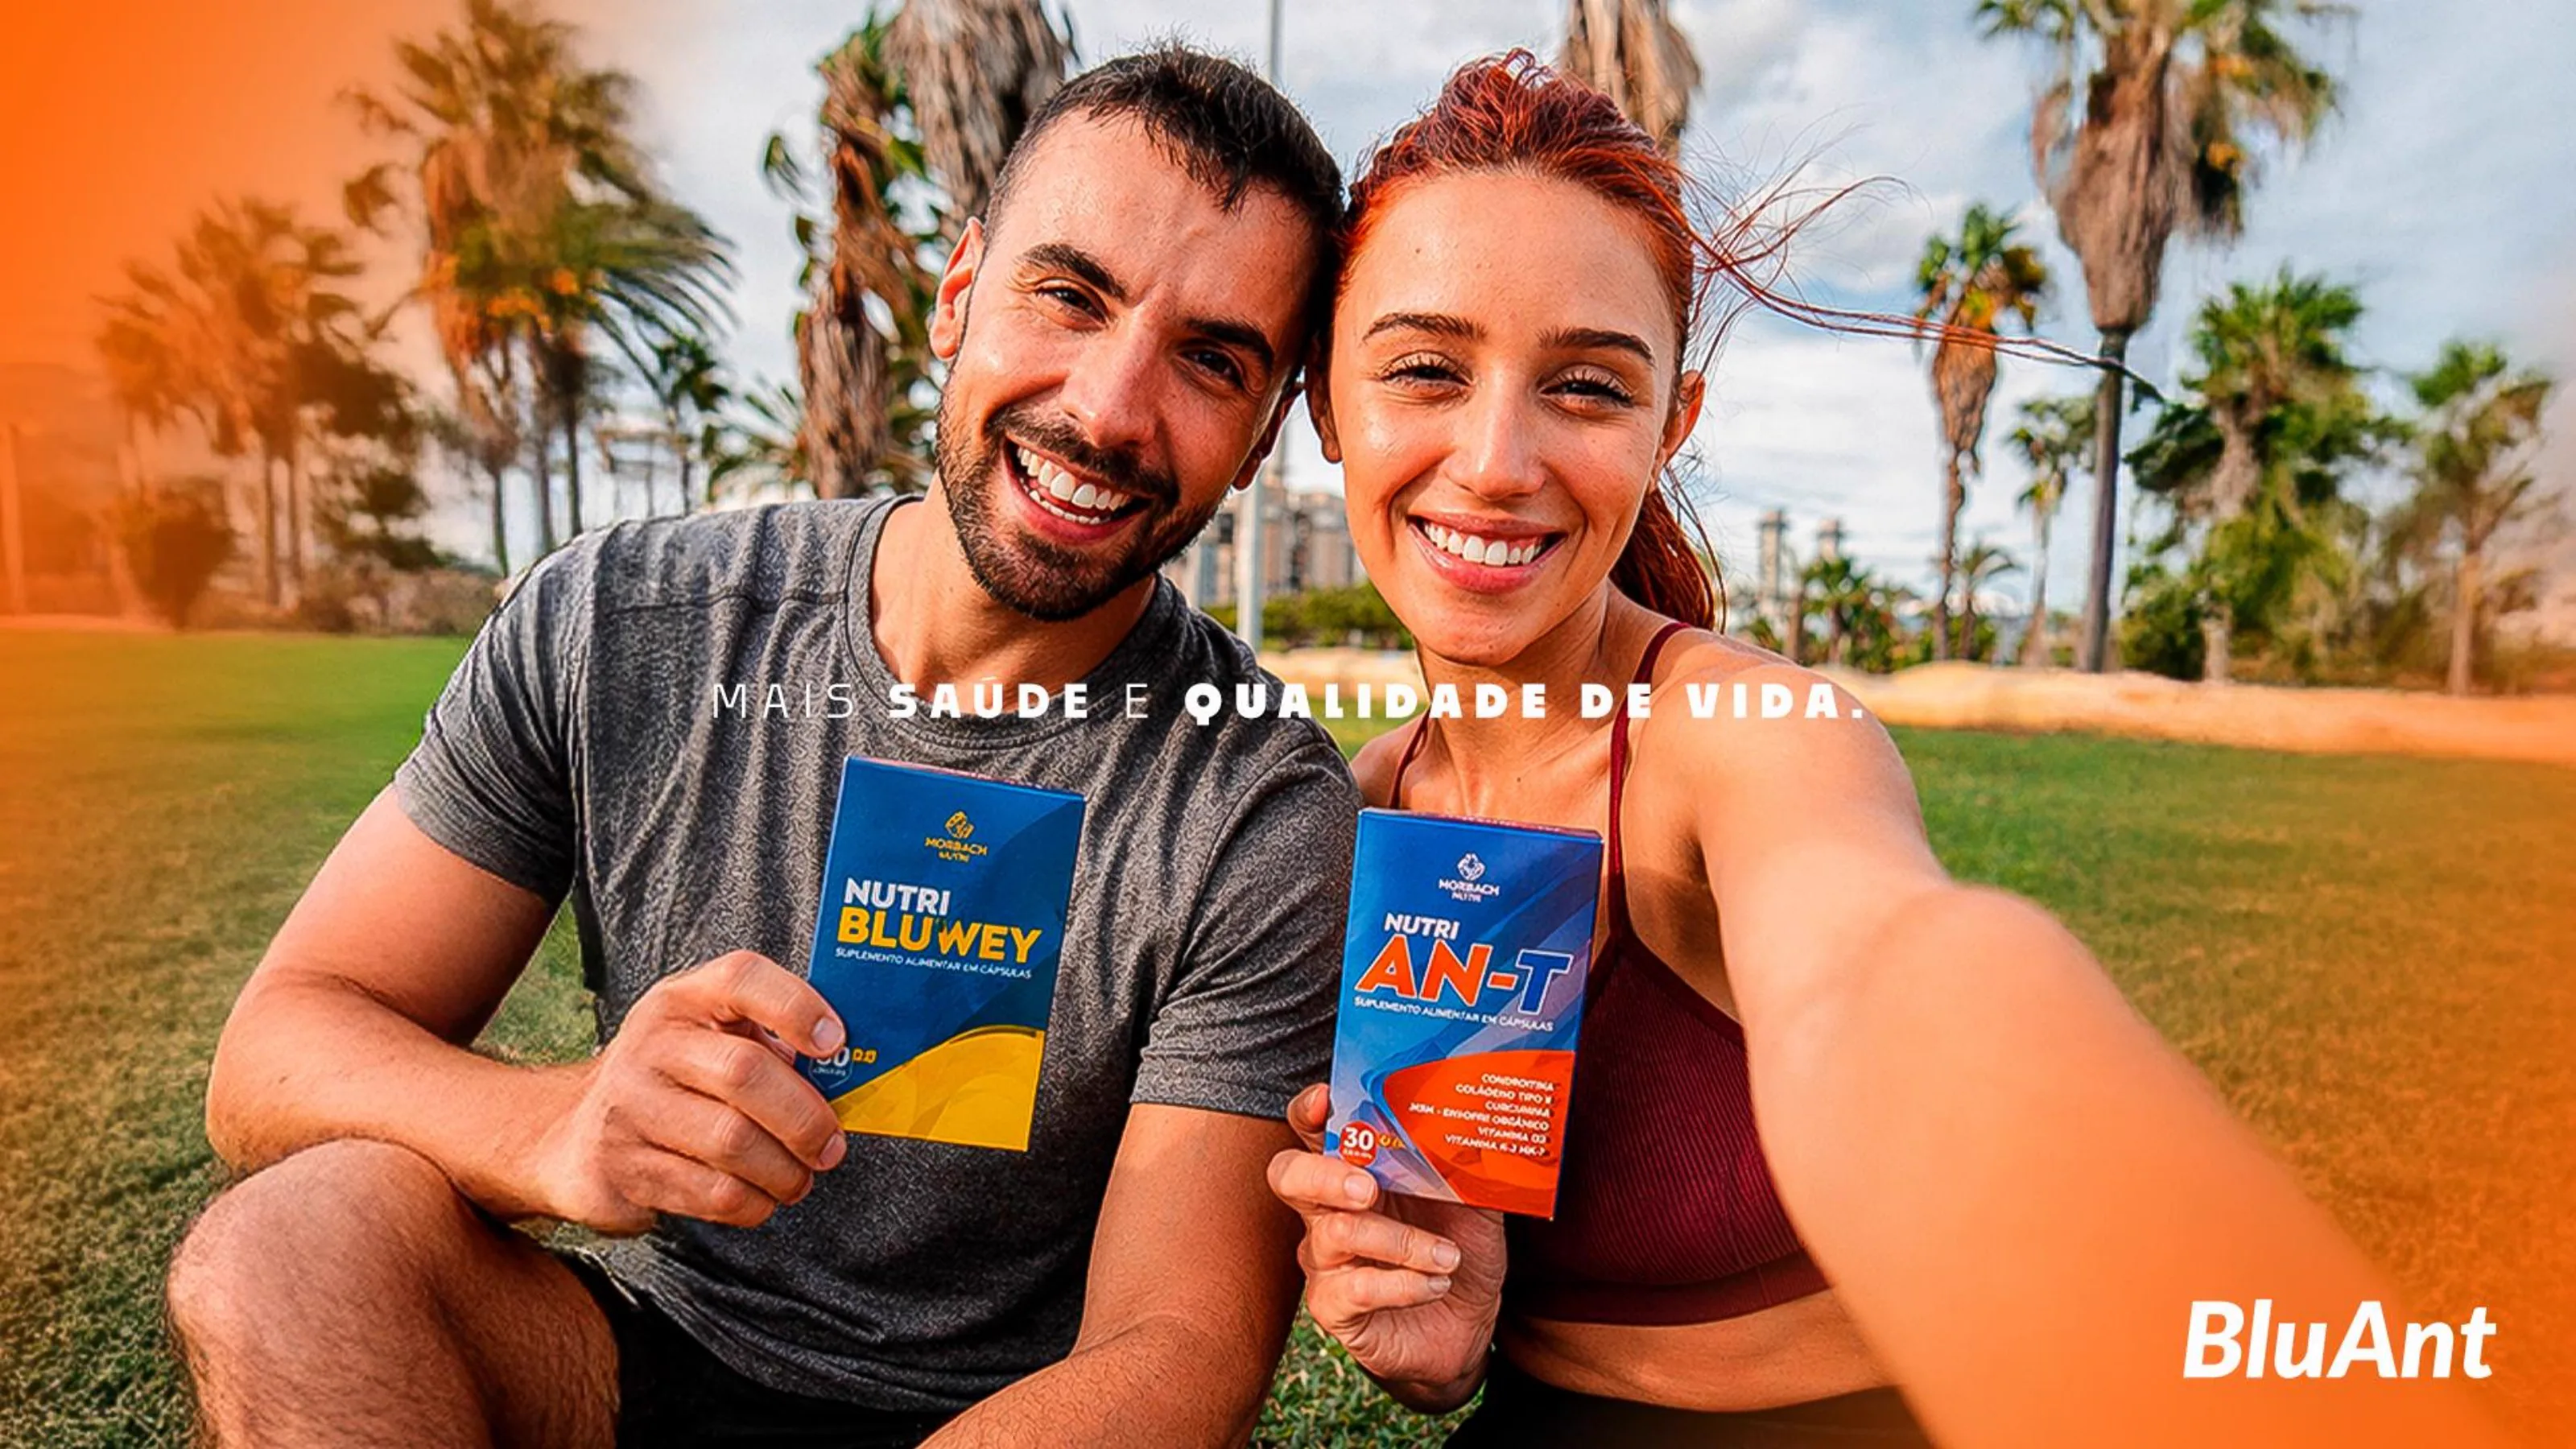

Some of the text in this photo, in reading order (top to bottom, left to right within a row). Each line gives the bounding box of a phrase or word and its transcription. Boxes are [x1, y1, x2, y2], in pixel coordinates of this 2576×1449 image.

[844, 877, 952, 916] NUTRI
[1384, 912, 1460, 940] NUTRI
[1354, 933, 1575, 1015] AN-T
[1344, 1126, 1375, 1151] 30
